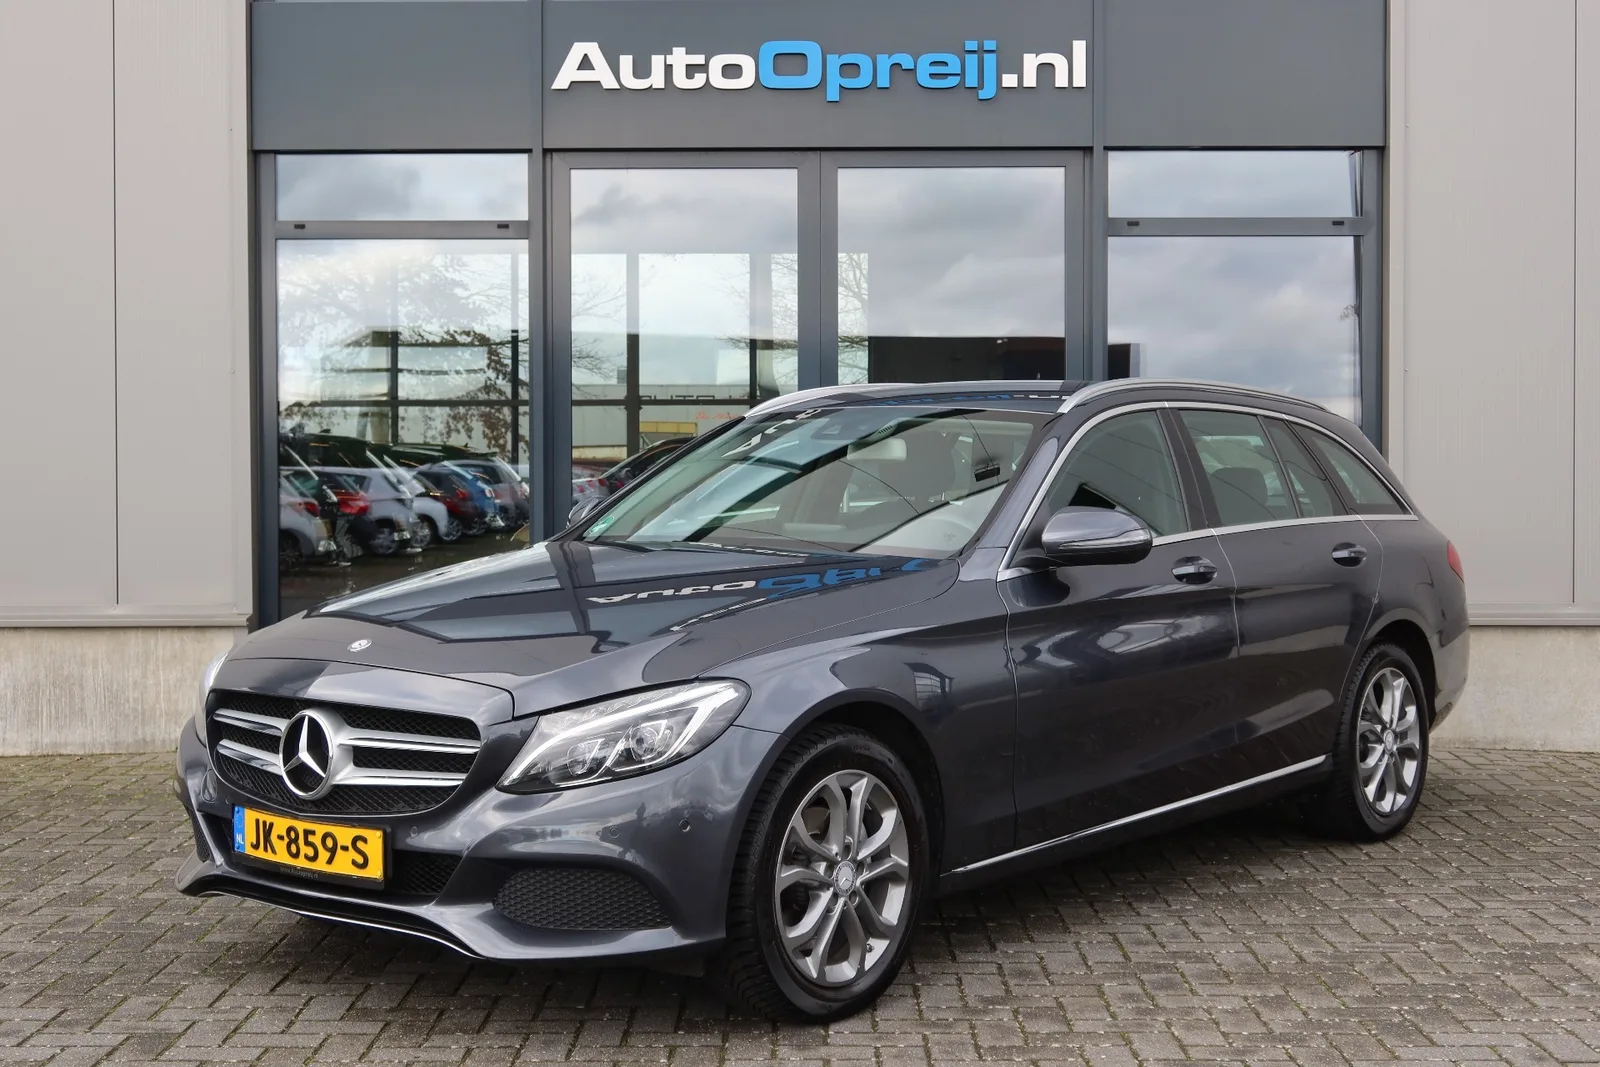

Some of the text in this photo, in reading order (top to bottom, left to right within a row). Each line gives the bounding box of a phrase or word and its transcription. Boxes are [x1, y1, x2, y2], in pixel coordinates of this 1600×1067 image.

[551, 40, 1087, 102] AutoOpreij.nl
[236, 833, 244, 844] NL
[250, 818, 369, 869] JK-859-S
